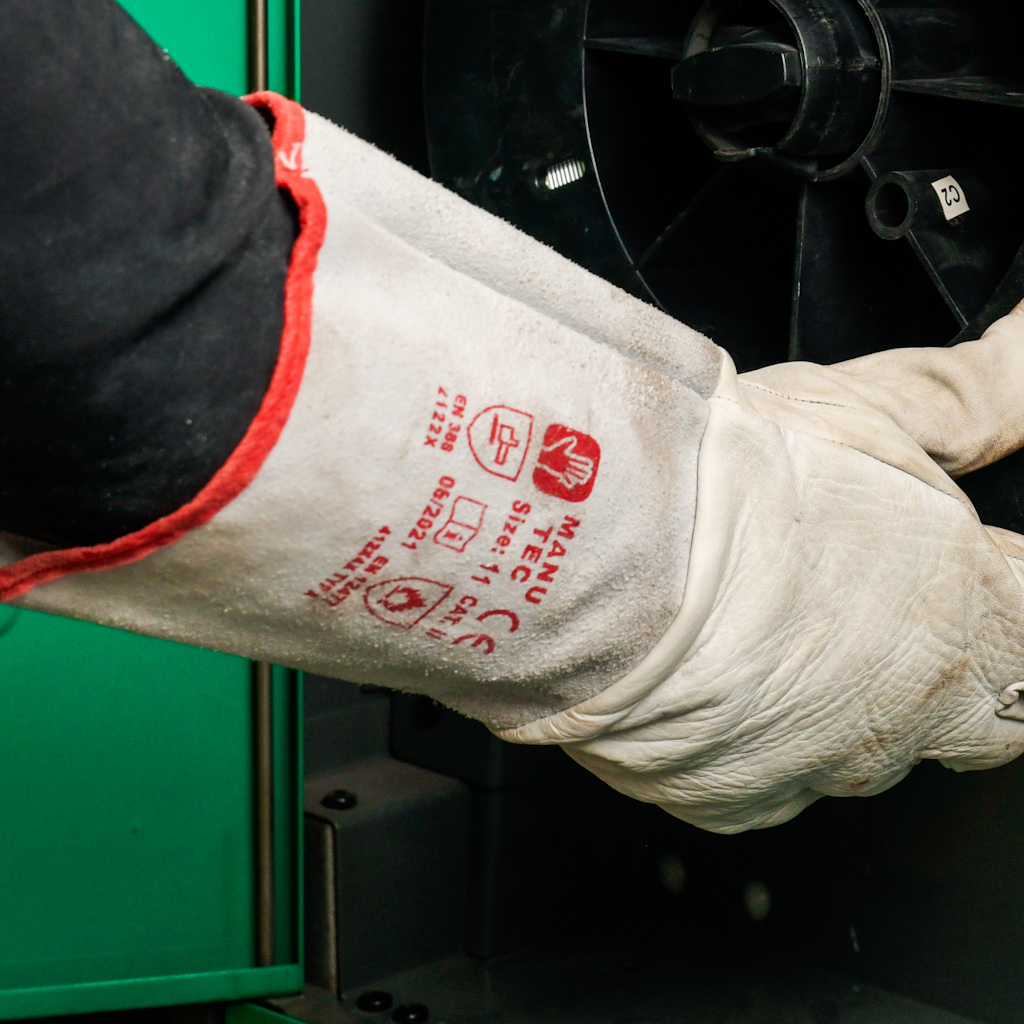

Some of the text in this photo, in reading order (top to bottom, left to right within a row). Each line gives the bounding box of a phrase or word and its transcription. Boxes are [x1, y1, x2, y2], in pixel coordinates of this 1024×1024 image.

[941, 185, 960, 206] C2
[441, 394, 467, 452] EN 388
[401, 476, 455, 550] 06/2021
[471, 499, 531, 585] Size: 11
[511, 526, 553, 583] TEC
[525, 514, 580, 605] MANU
[439, 595, 478, 626] CAT.
